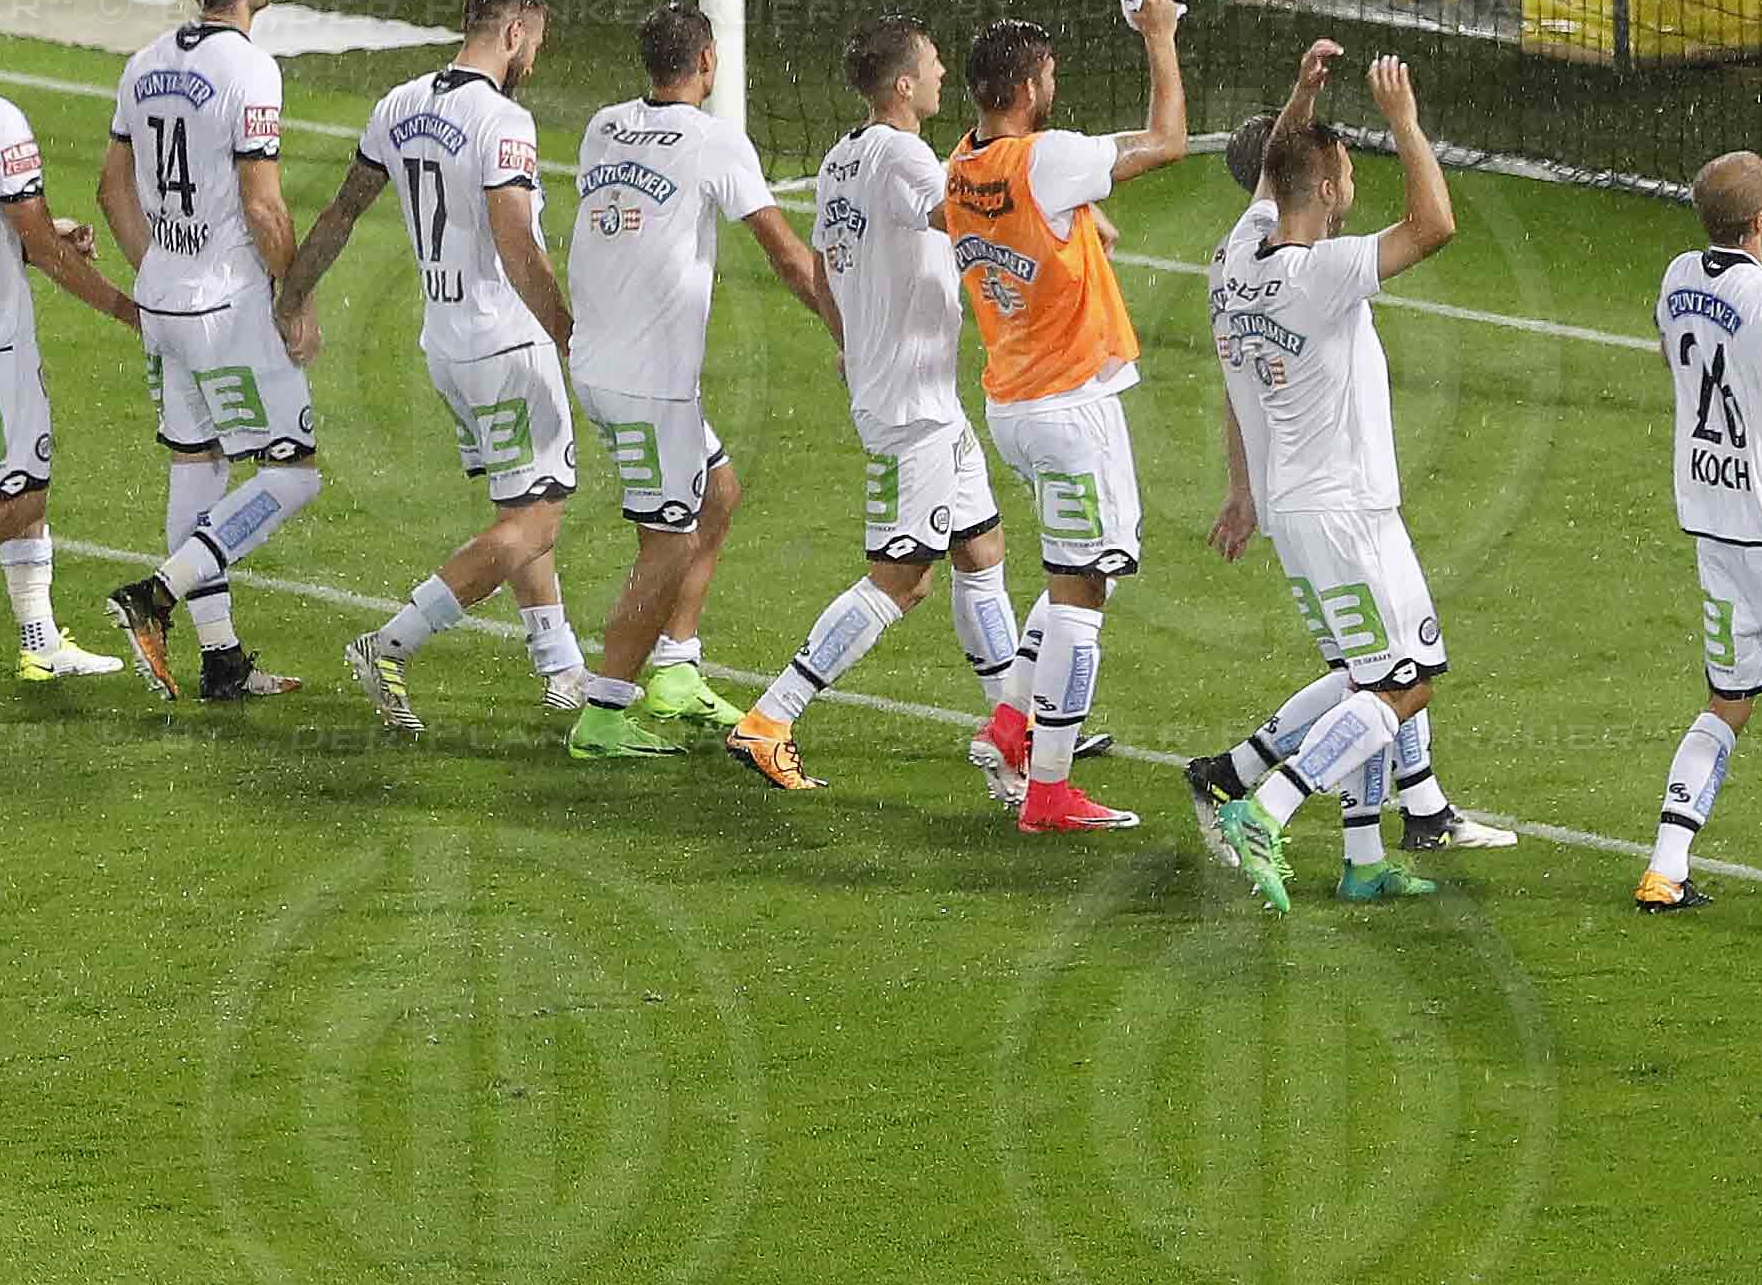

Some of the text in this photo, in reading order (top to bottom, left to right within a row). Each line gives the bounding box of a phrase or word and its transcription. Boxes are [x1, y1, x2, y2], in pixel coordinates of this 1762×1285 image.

[147, 116, 197, 218] 14
[578, 161, 678, 206] PUNTIGAMER
[403, 157, 447, 262] 17
[420, 269, 465, 303] ULJ
[1679, 331, 1746, 449] 26
[1690, 447, 1751, 491] KOCH
